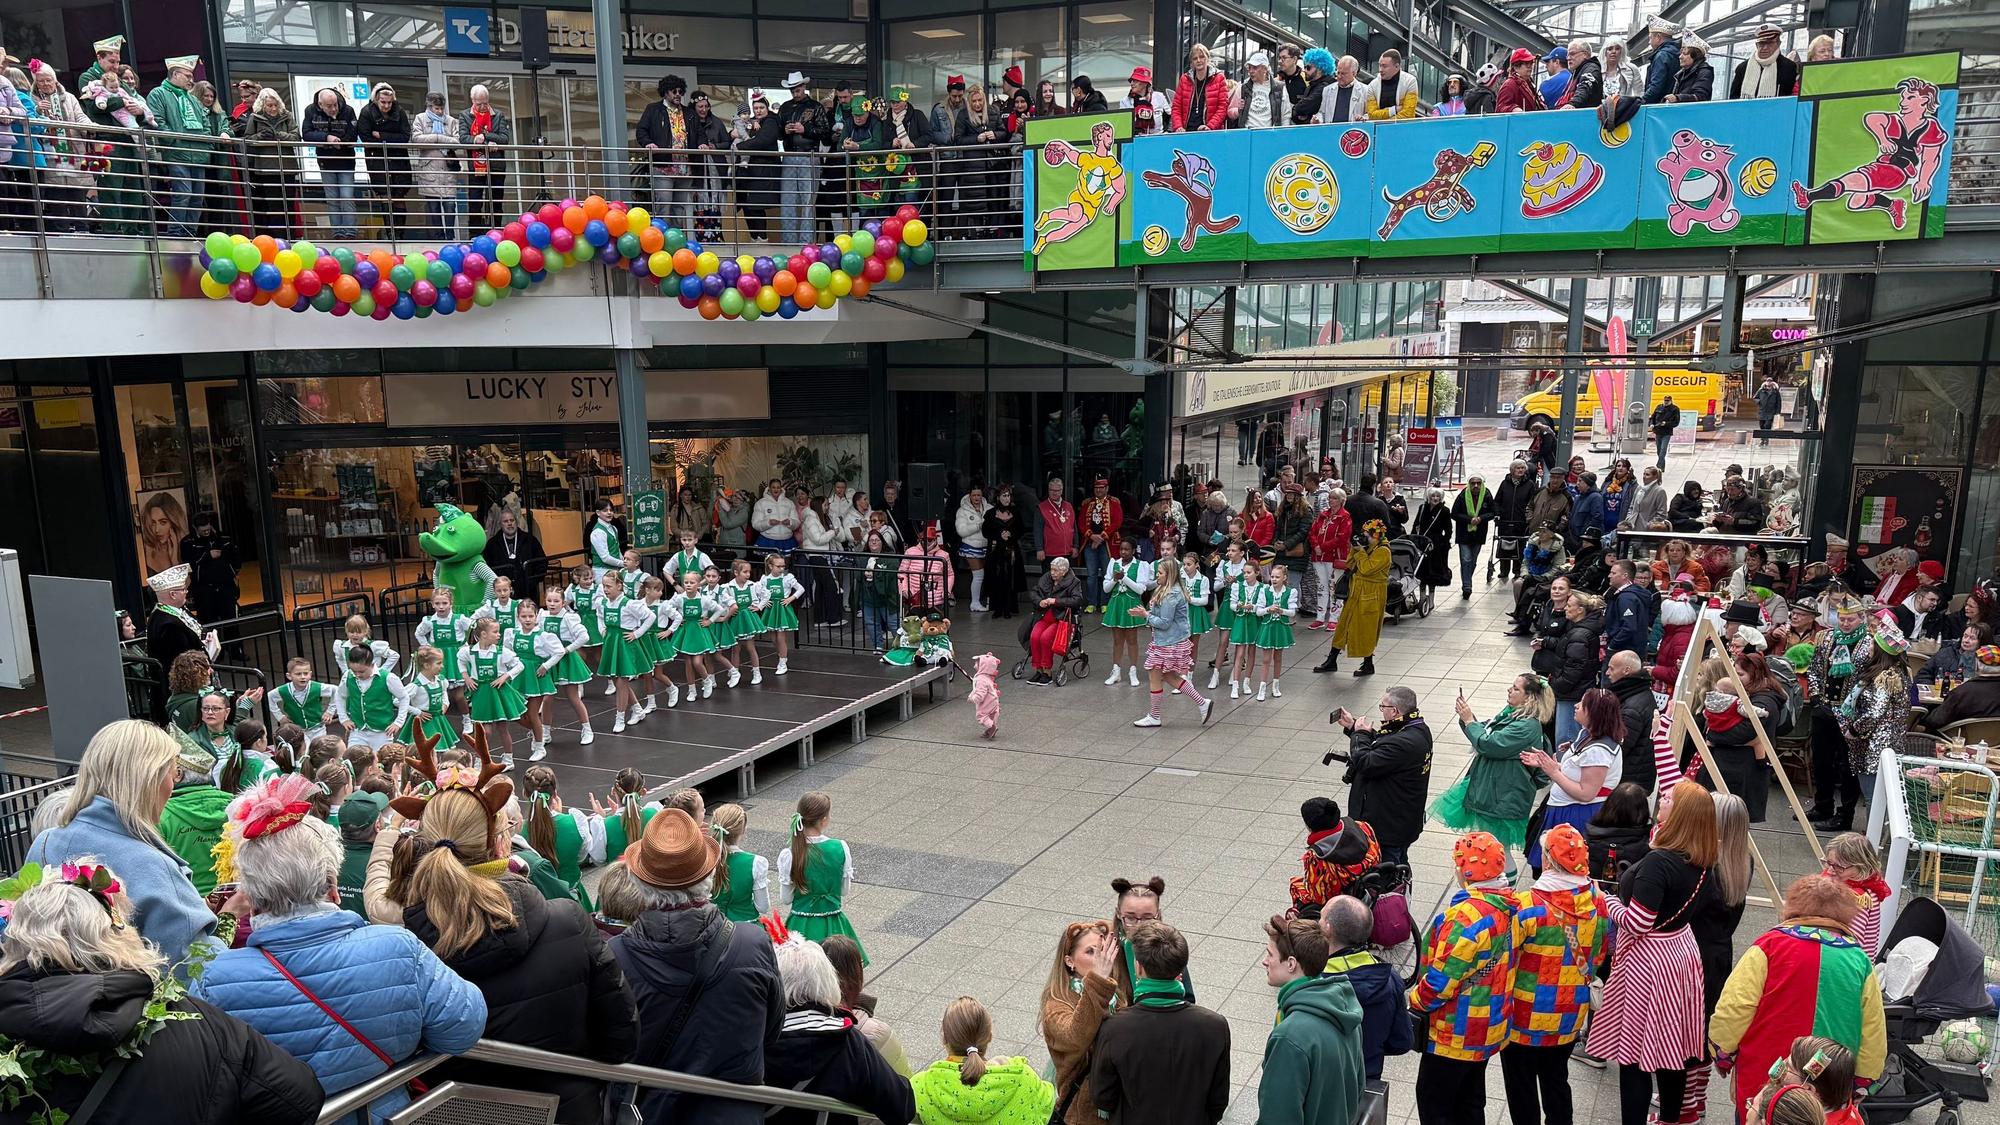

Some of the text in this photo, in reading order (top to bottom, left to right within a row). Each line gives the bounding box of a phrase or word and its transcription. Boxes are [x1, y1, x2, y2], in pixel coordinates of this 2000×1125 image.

[451, 18, 482, 44] TK
[551, 23, 680, 50] Tecniker
[465, 376, 614, 400] LUCKY STY
[1654, 376, 1707, 386] OSEGUR
